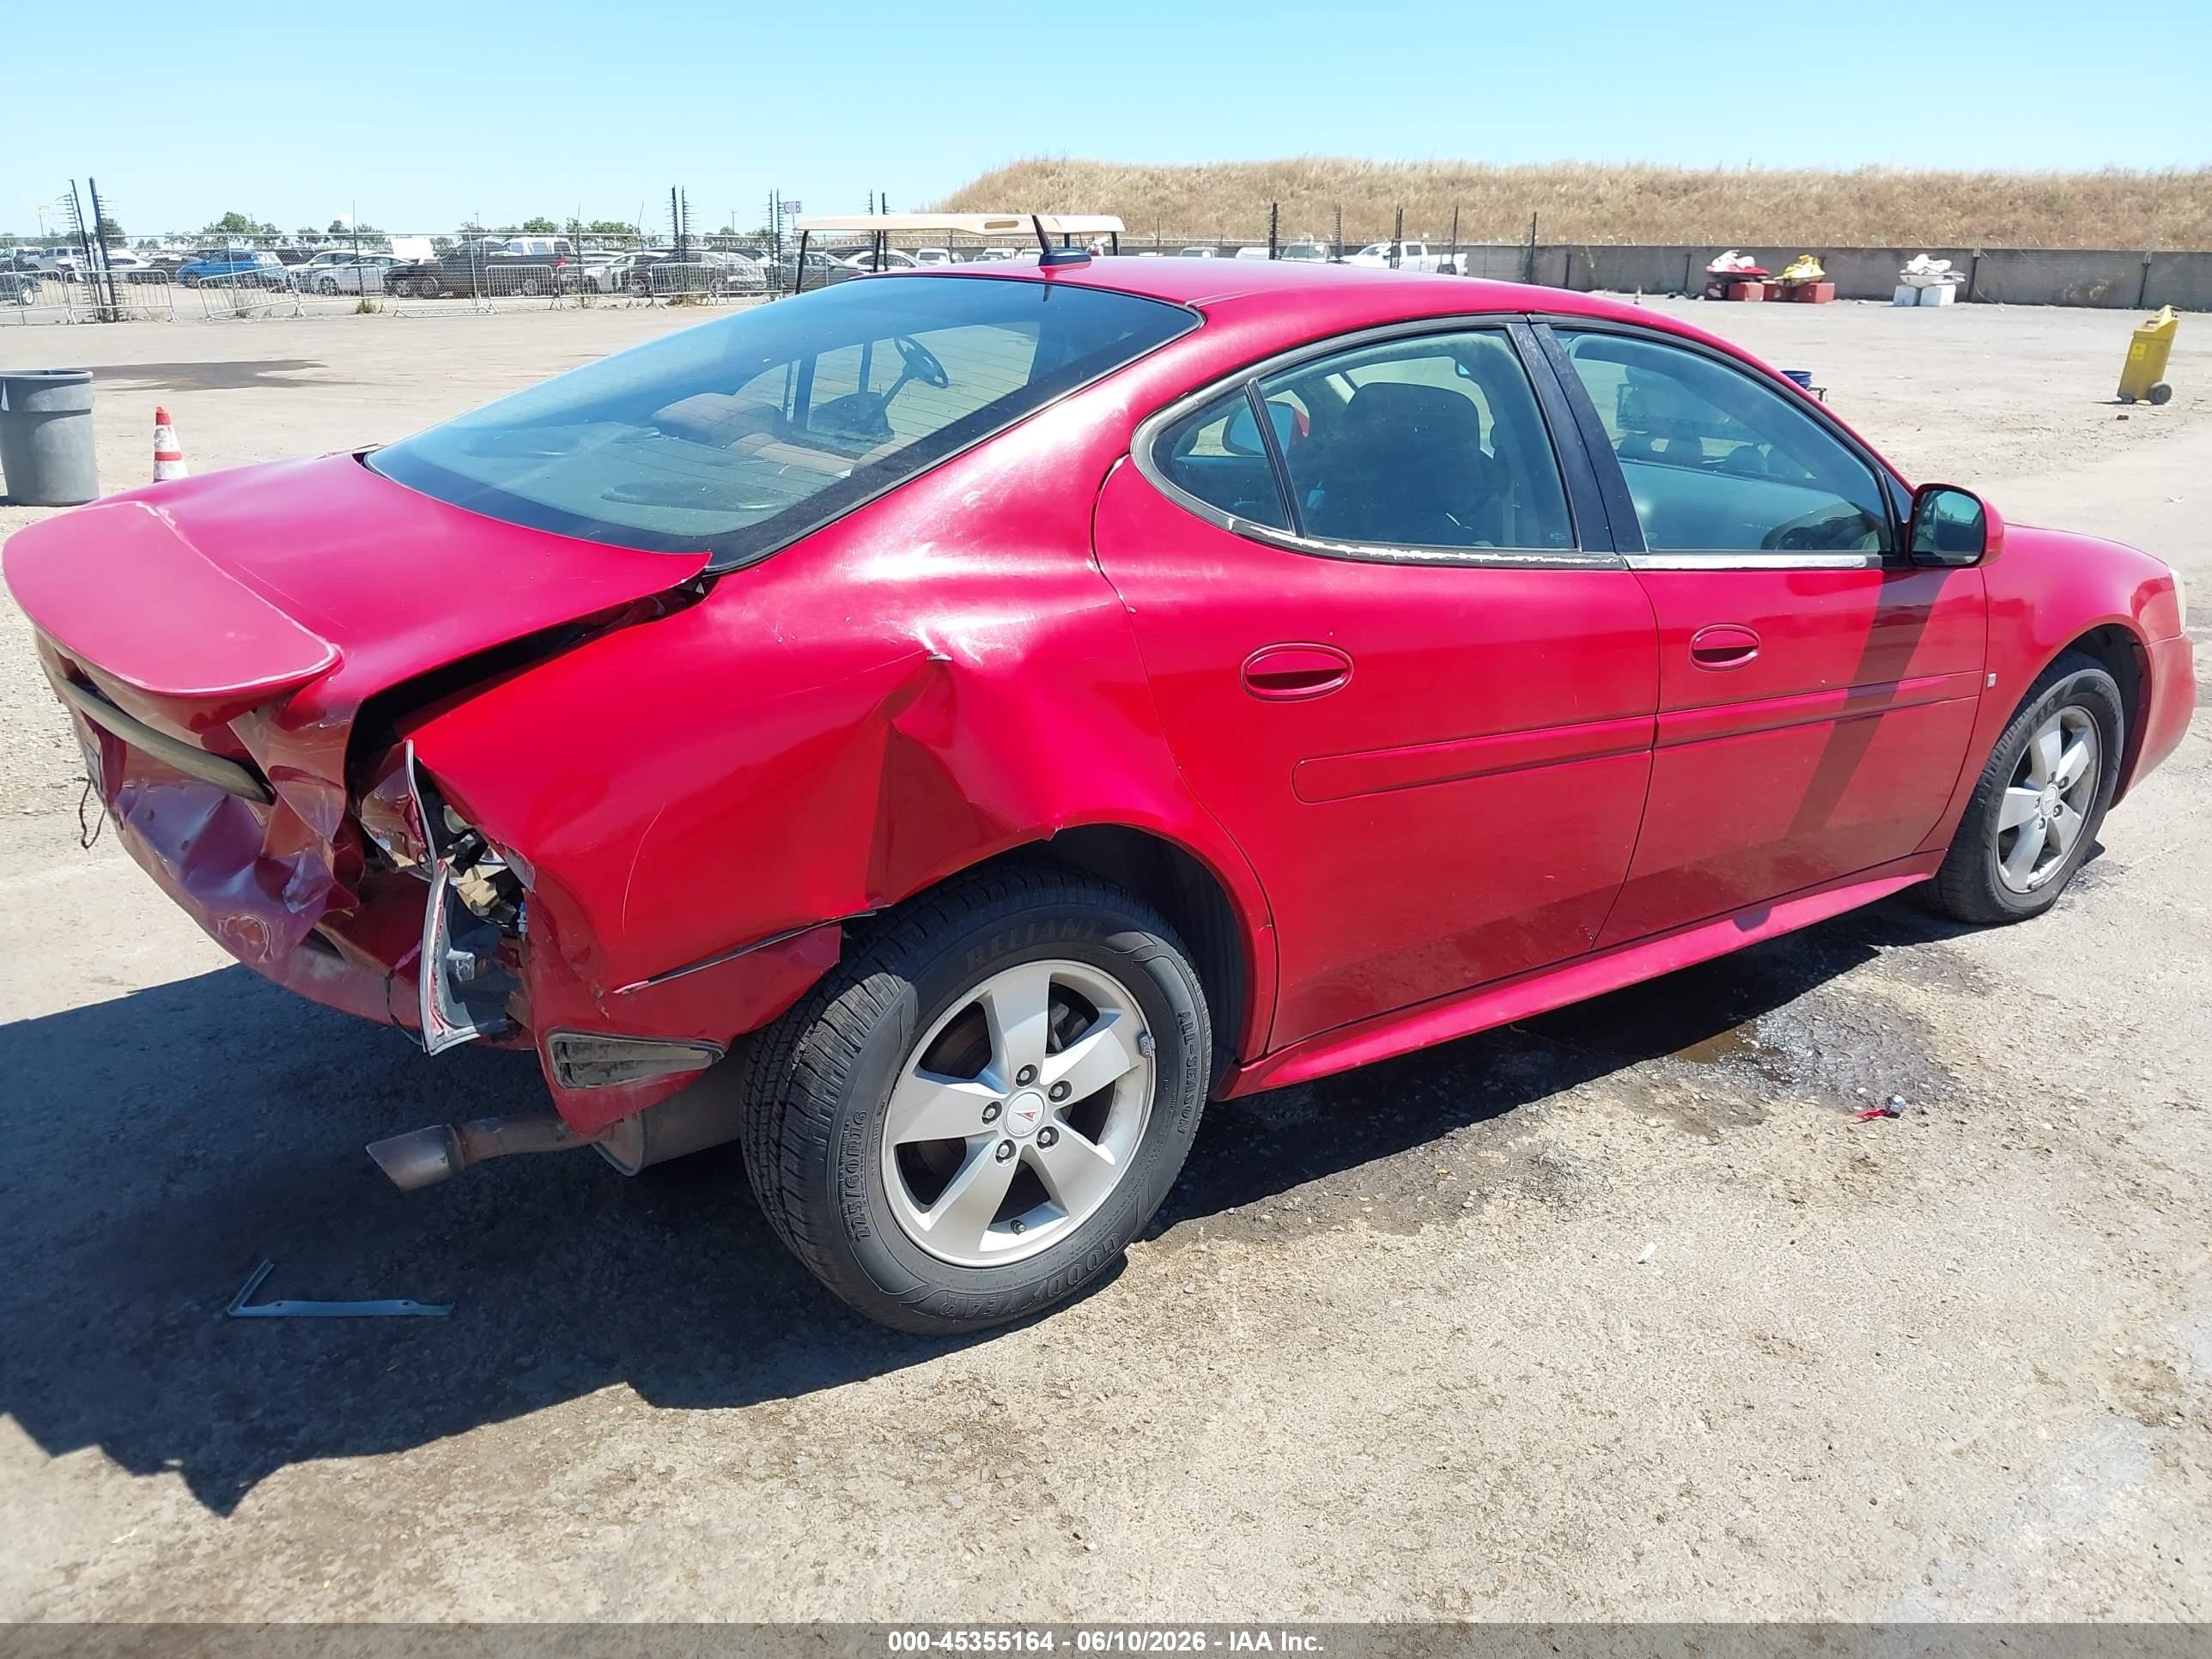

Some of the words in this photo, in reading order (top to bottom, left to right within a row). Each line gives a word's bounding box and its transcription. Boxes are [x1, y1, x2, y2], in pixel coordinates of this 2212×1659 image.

[966, 919, 1103, 974] RELIANT
[1176, 1010, 1198, 1134] ALL-SEASON
[845, 1110, 872, 1243] 225/60R16
